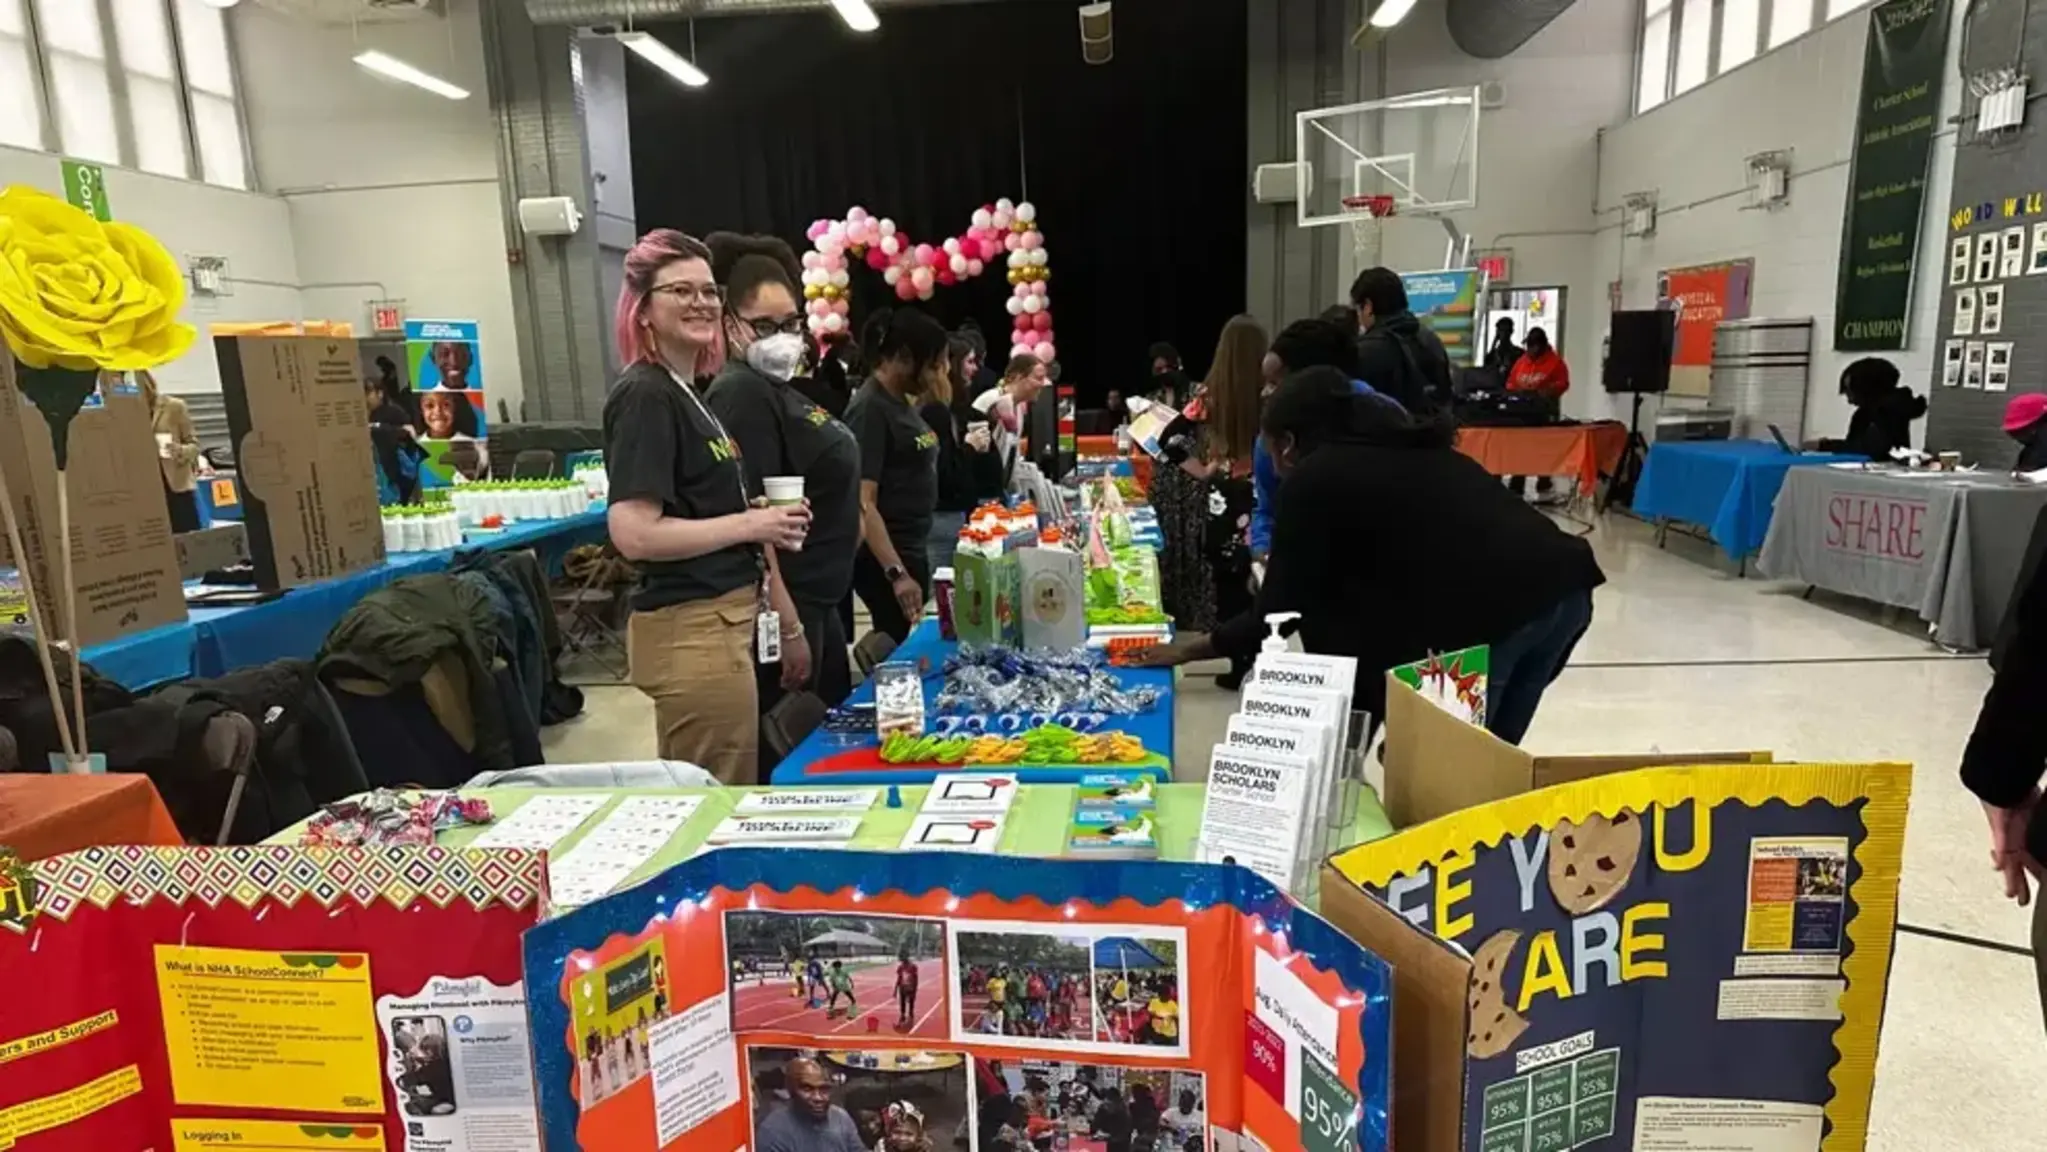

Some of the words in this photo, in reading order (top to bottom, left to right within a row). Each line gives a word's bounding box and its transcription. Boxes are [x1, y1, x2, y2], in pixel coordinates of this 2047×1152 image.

[1827, 498, 1926, 559] SHARE
[1259, 669, 1324, 685] BROOKLYN
[1245, 700, 1311, 718] BROOKLYN
[1230, 731, 1296, 751] BROOKLYN
[1214, 760, 1281, 780] BROOKLYN
[1211, 773, 1276, 792] SCHOLARS
[165, 961, 193, 972] What
[196, 963, 205, 973] is
[207, 965, 231, 974] NHA
[235, 965, 325, 979] SchoolConnect?
[26, 1032, 56, 1049] and
[59, 1011, 115, 1038] Support
[1517, 1045, 1558, 1068] SCHOOL
[1559, 1034, 1593, 1054] GOALS
[1582, 1077, 1609, 1097] 95%
[1490, 1100, 1520, 1120] 95%
[1536, 1091, 1564, 1111] 95%
[1305, 1087, 1353, 1152] 95%
[1580, 1115, 1605, 1134] 75%
[184, 1131, 229, 1142] Logging
[1536, 1131, 1564, 1149] 75%
